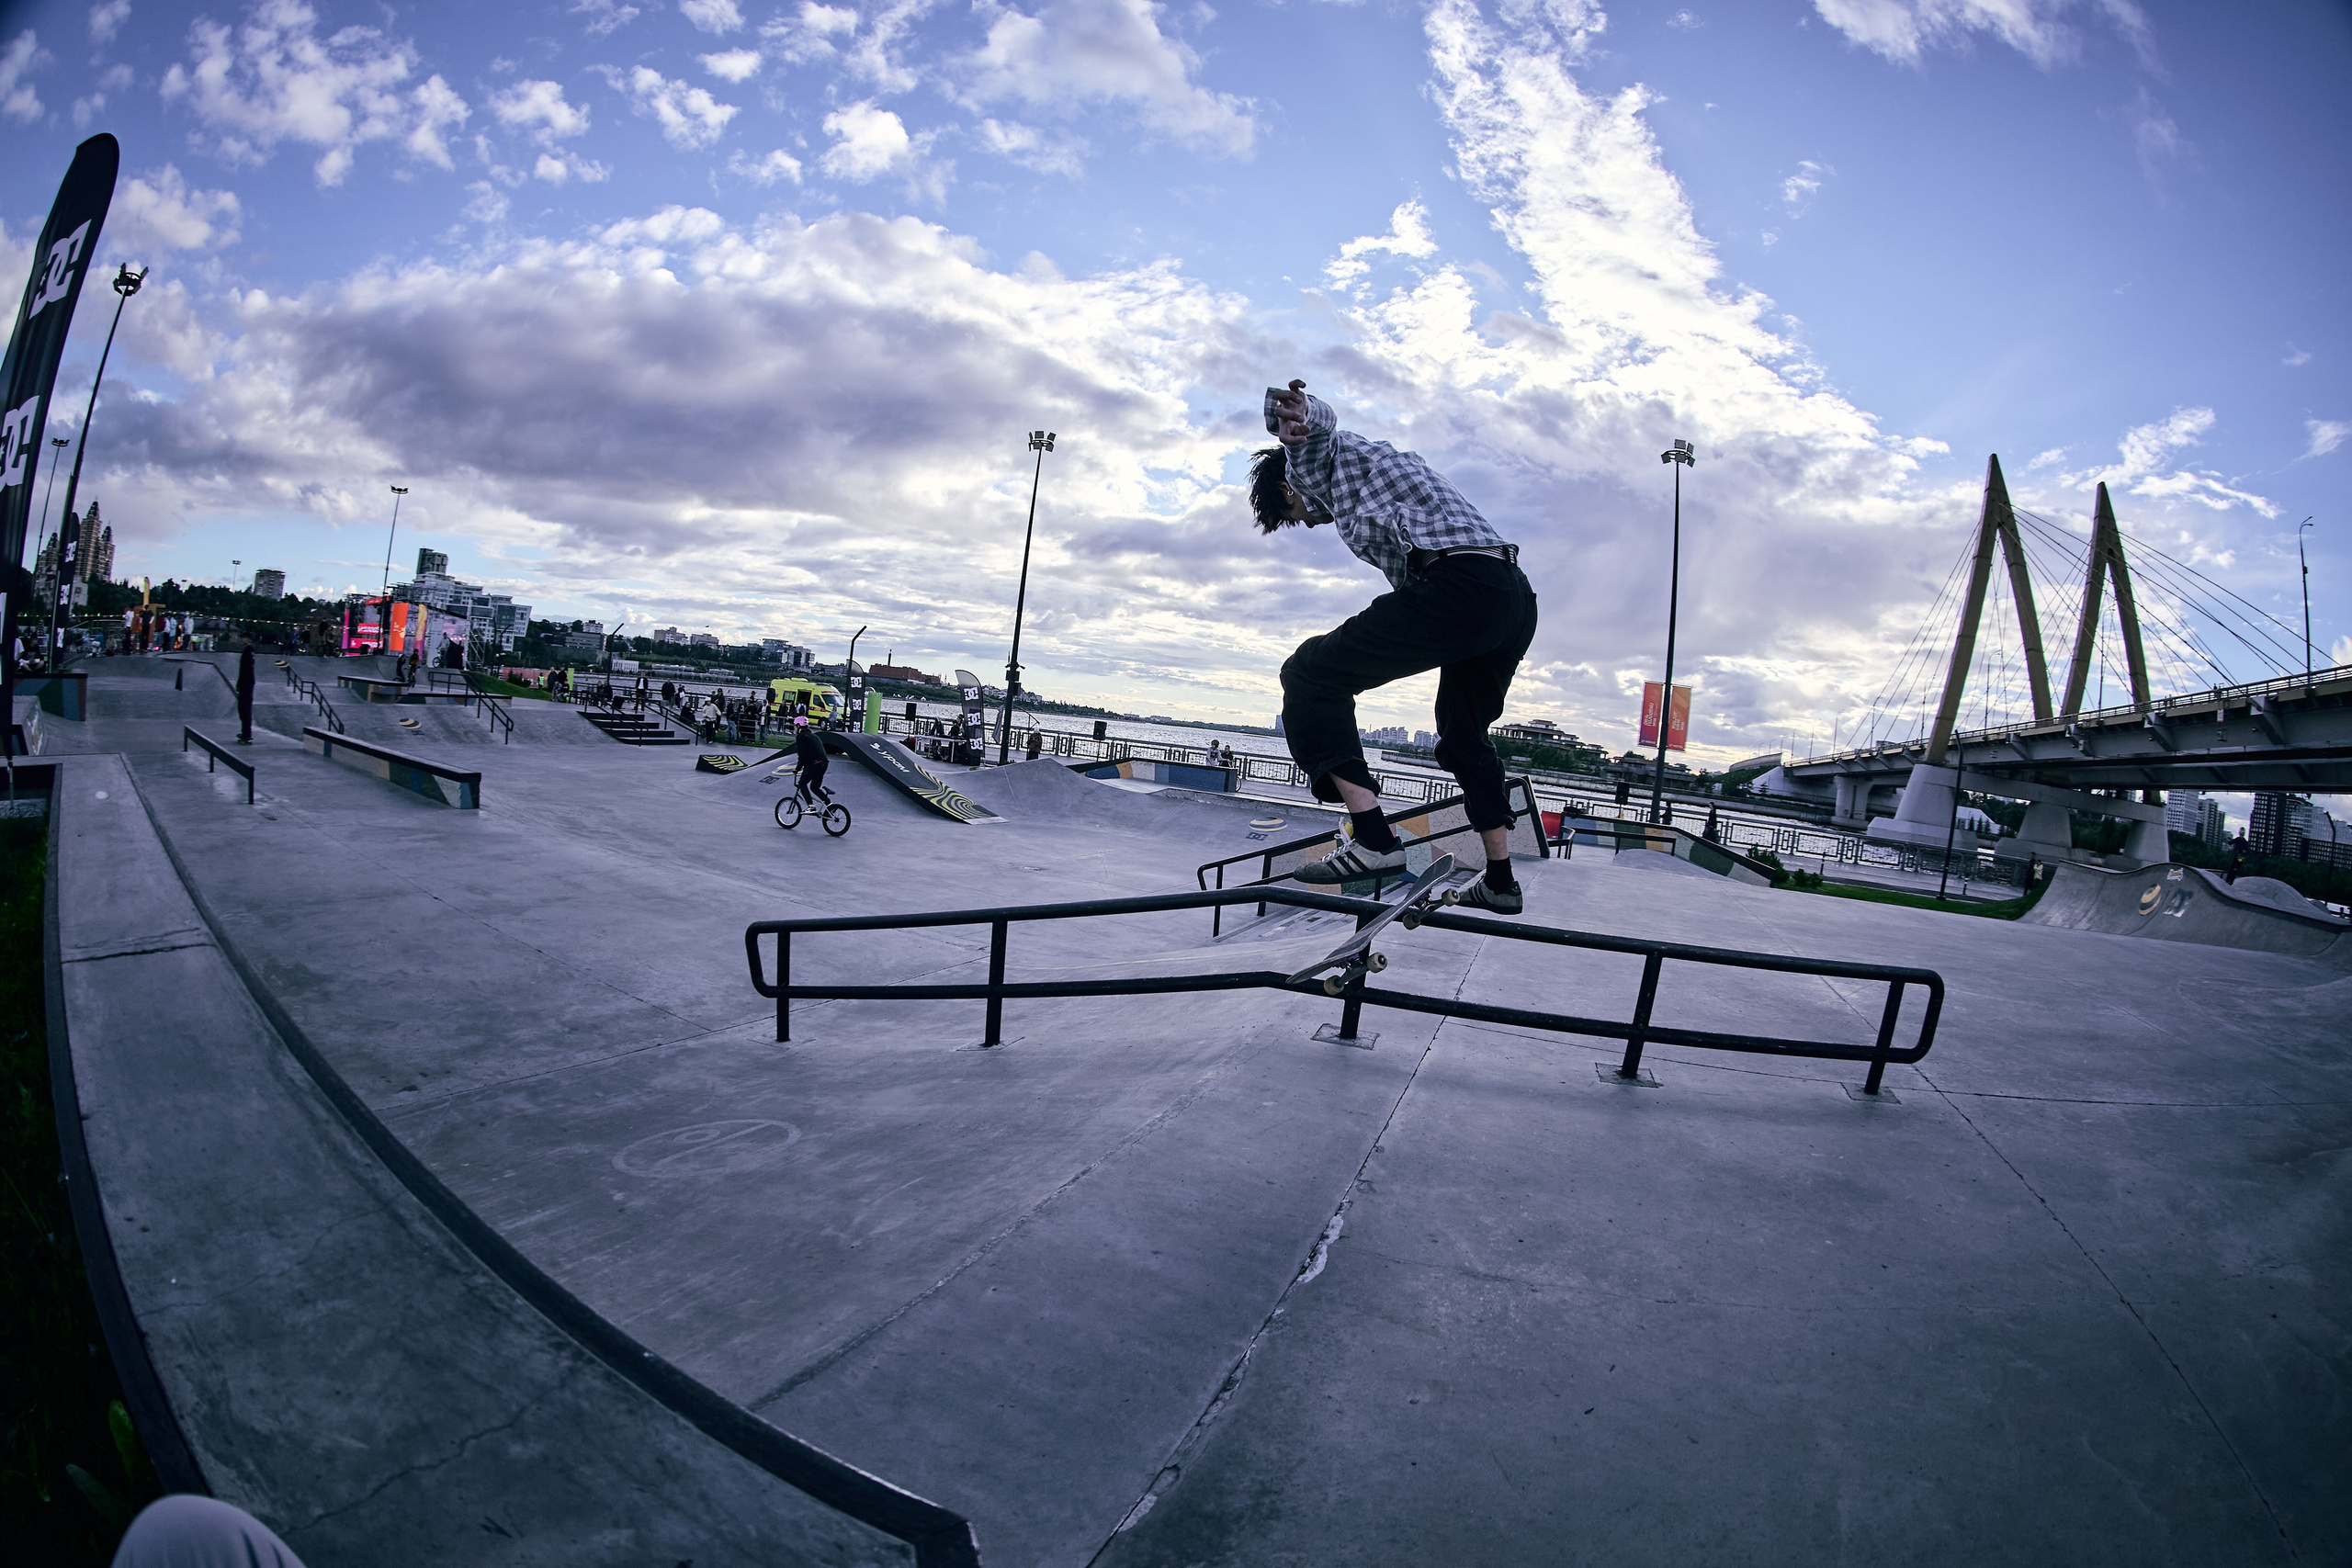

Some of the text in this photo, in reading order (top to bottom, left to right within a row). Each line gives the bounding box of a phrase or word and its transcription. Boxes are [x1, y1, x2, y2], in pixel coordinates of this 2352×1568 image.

[28, 219, 92, 321] DC
[850, 676, 862, 688] DC
[964, 686, 978, 701] DC
[967, 712, 981, 727] DC
[969, 737, 984, 750] DC
